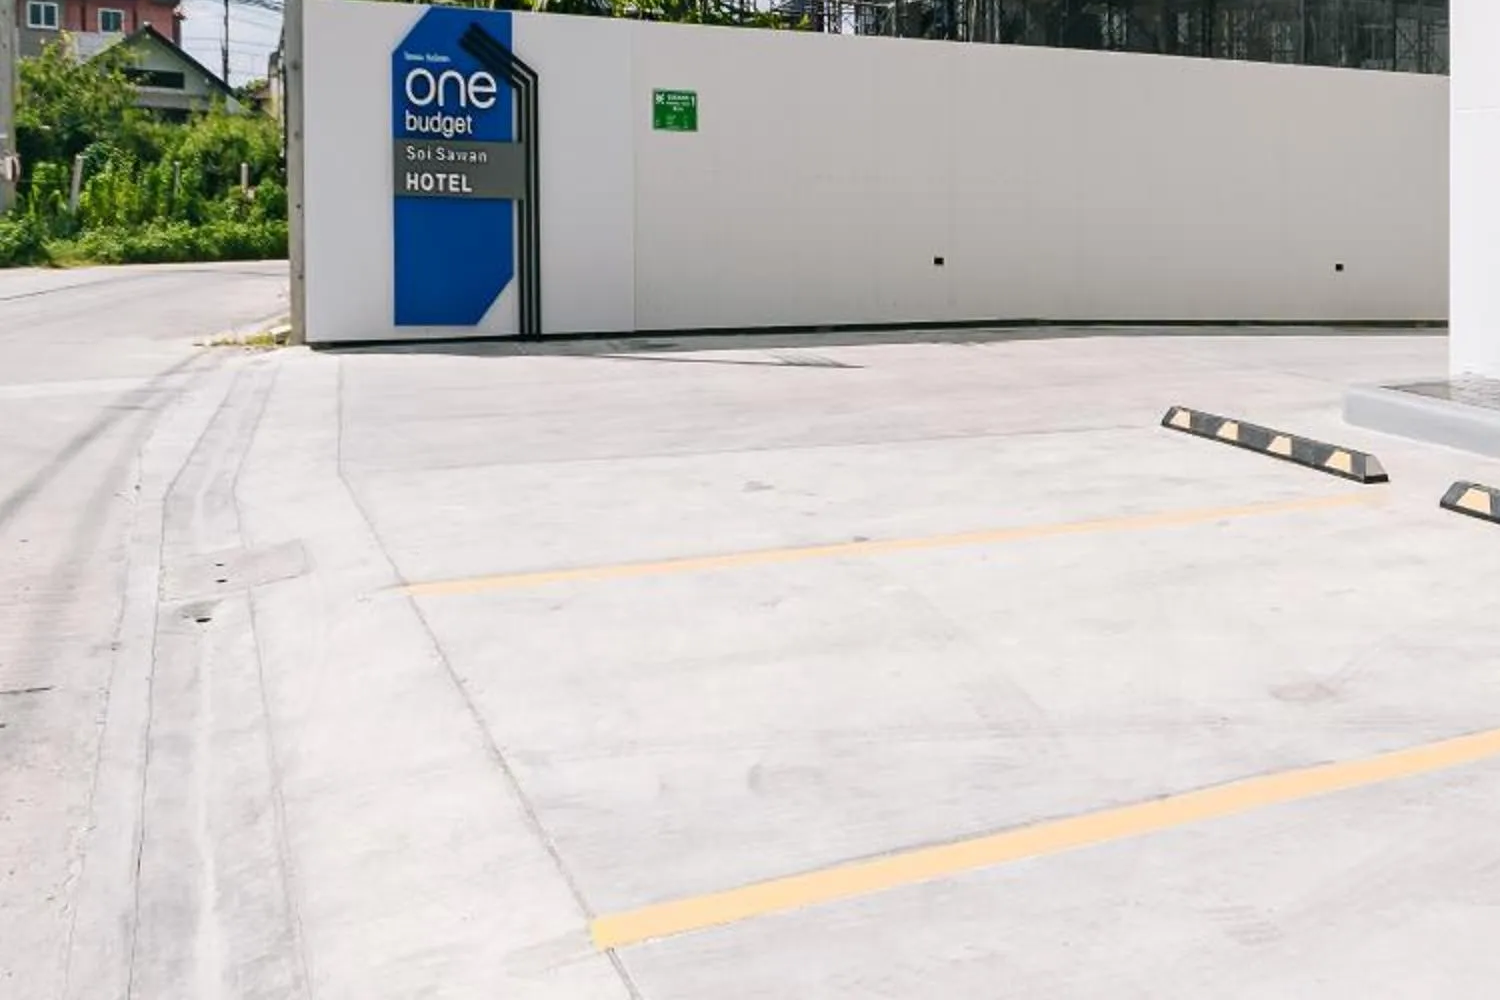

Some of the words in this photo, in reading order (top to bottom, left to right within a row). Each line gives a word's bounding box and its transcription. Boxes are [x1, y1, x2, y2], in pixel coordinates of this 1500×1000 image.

[405, 68, 497, 109] one
[405, 110, 472, 138] budget
[406, 172, 472, 192] HOTEL
